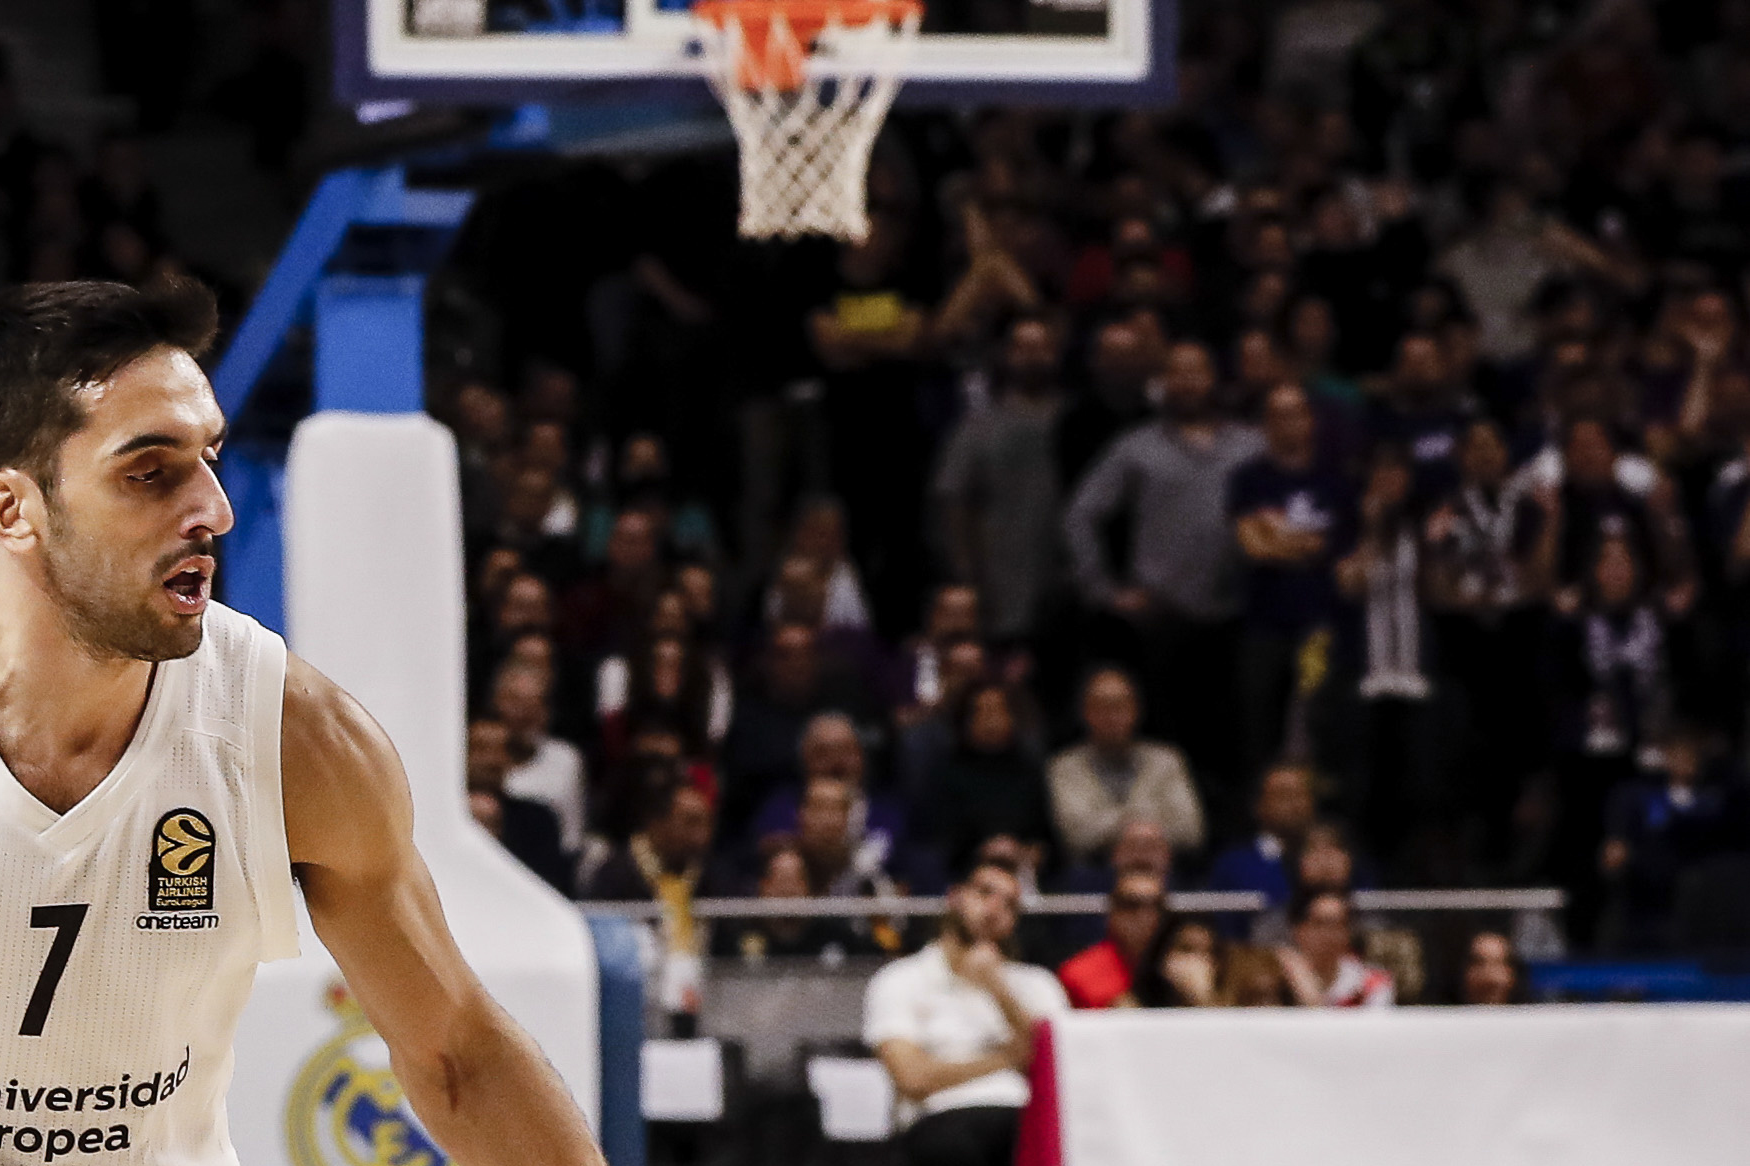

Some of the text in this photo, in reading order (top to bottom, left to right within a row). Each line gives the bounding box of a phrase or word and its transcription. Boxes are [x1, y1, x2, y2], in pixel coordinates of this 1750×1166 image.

[156, 876, 208, 887] TURKISH
[156, 887, 208, 897] AIRLINES
[18, 903, 90, 1037] 7
